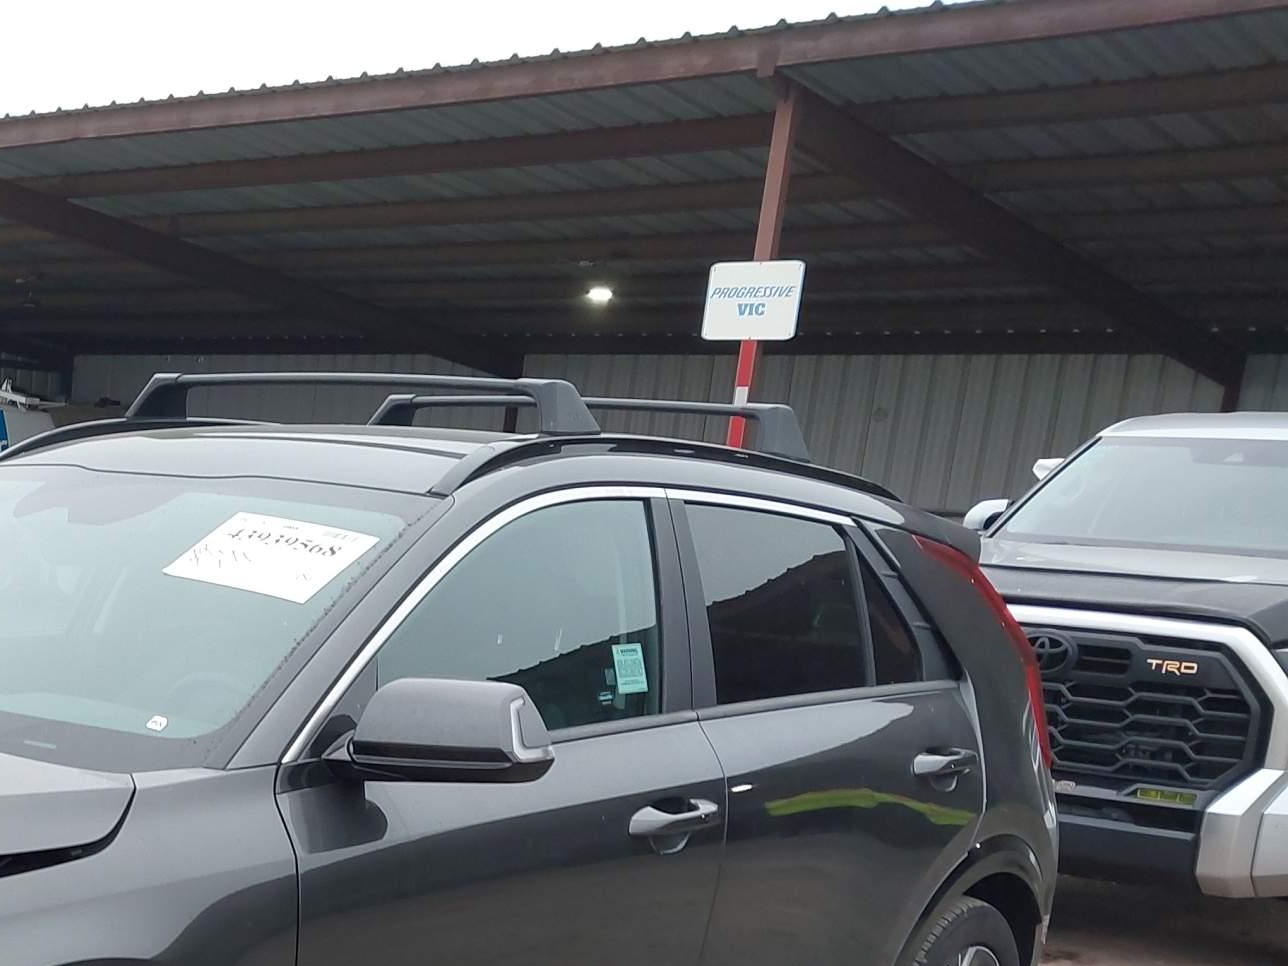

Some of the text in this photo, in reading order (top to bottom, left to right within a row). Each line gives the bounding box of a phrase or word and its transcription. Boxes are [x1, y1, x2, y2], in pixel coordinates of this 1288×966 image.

[710, 286, 797, 299] PROGRESSIVE
[737, 302, 766, 316] VIC
[1146, 658, 1198, 675] TRD
